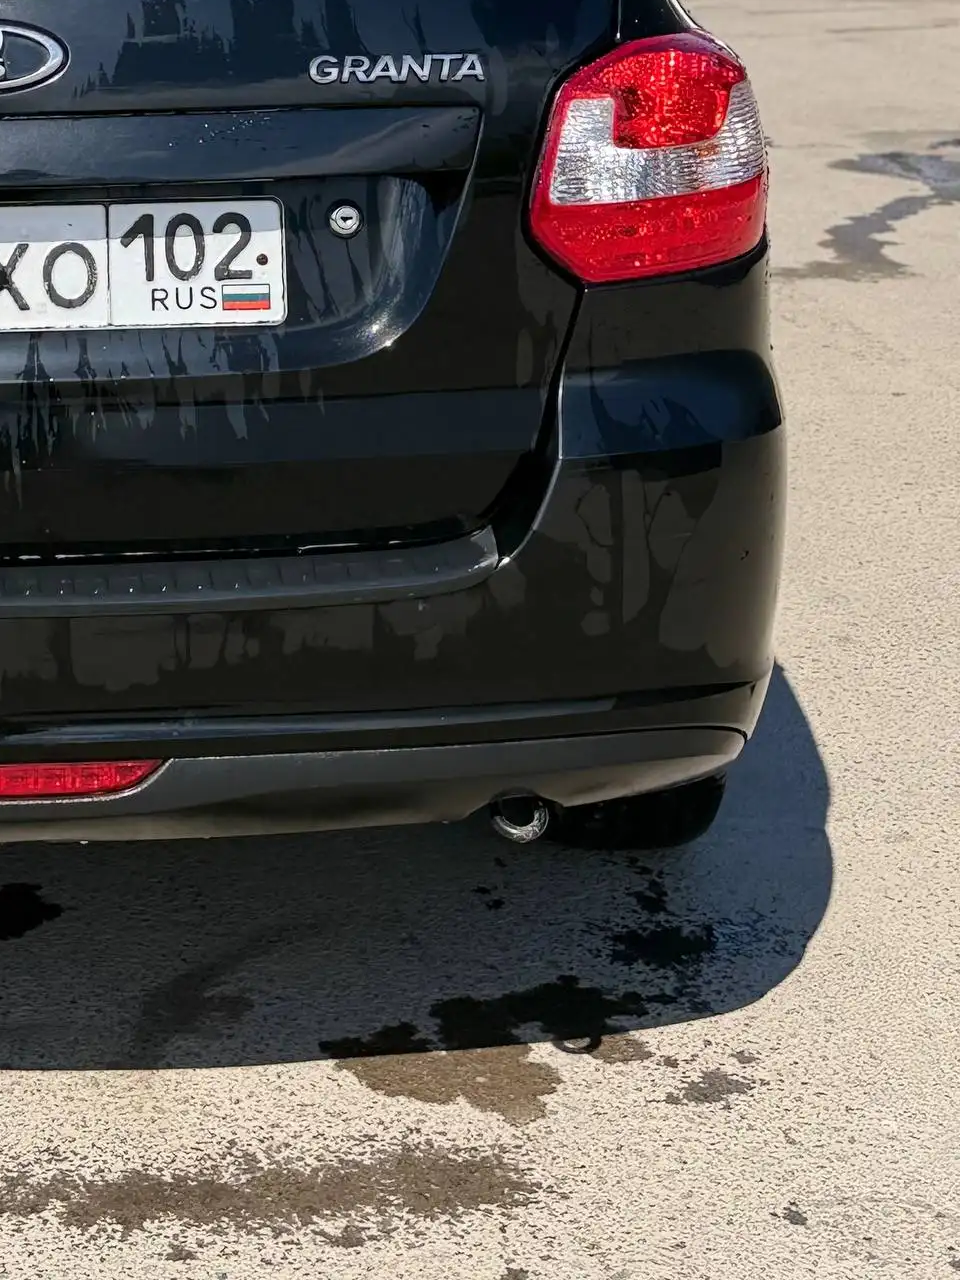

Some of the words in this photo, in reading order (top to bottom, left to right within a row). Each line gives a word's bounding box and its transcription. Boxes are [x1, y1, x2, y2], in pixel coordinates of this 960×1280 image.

[309, 53, 485, 84] GRANTA
[120, 211, 253, 282] 102
[151, 286, 218, 311] RUS
